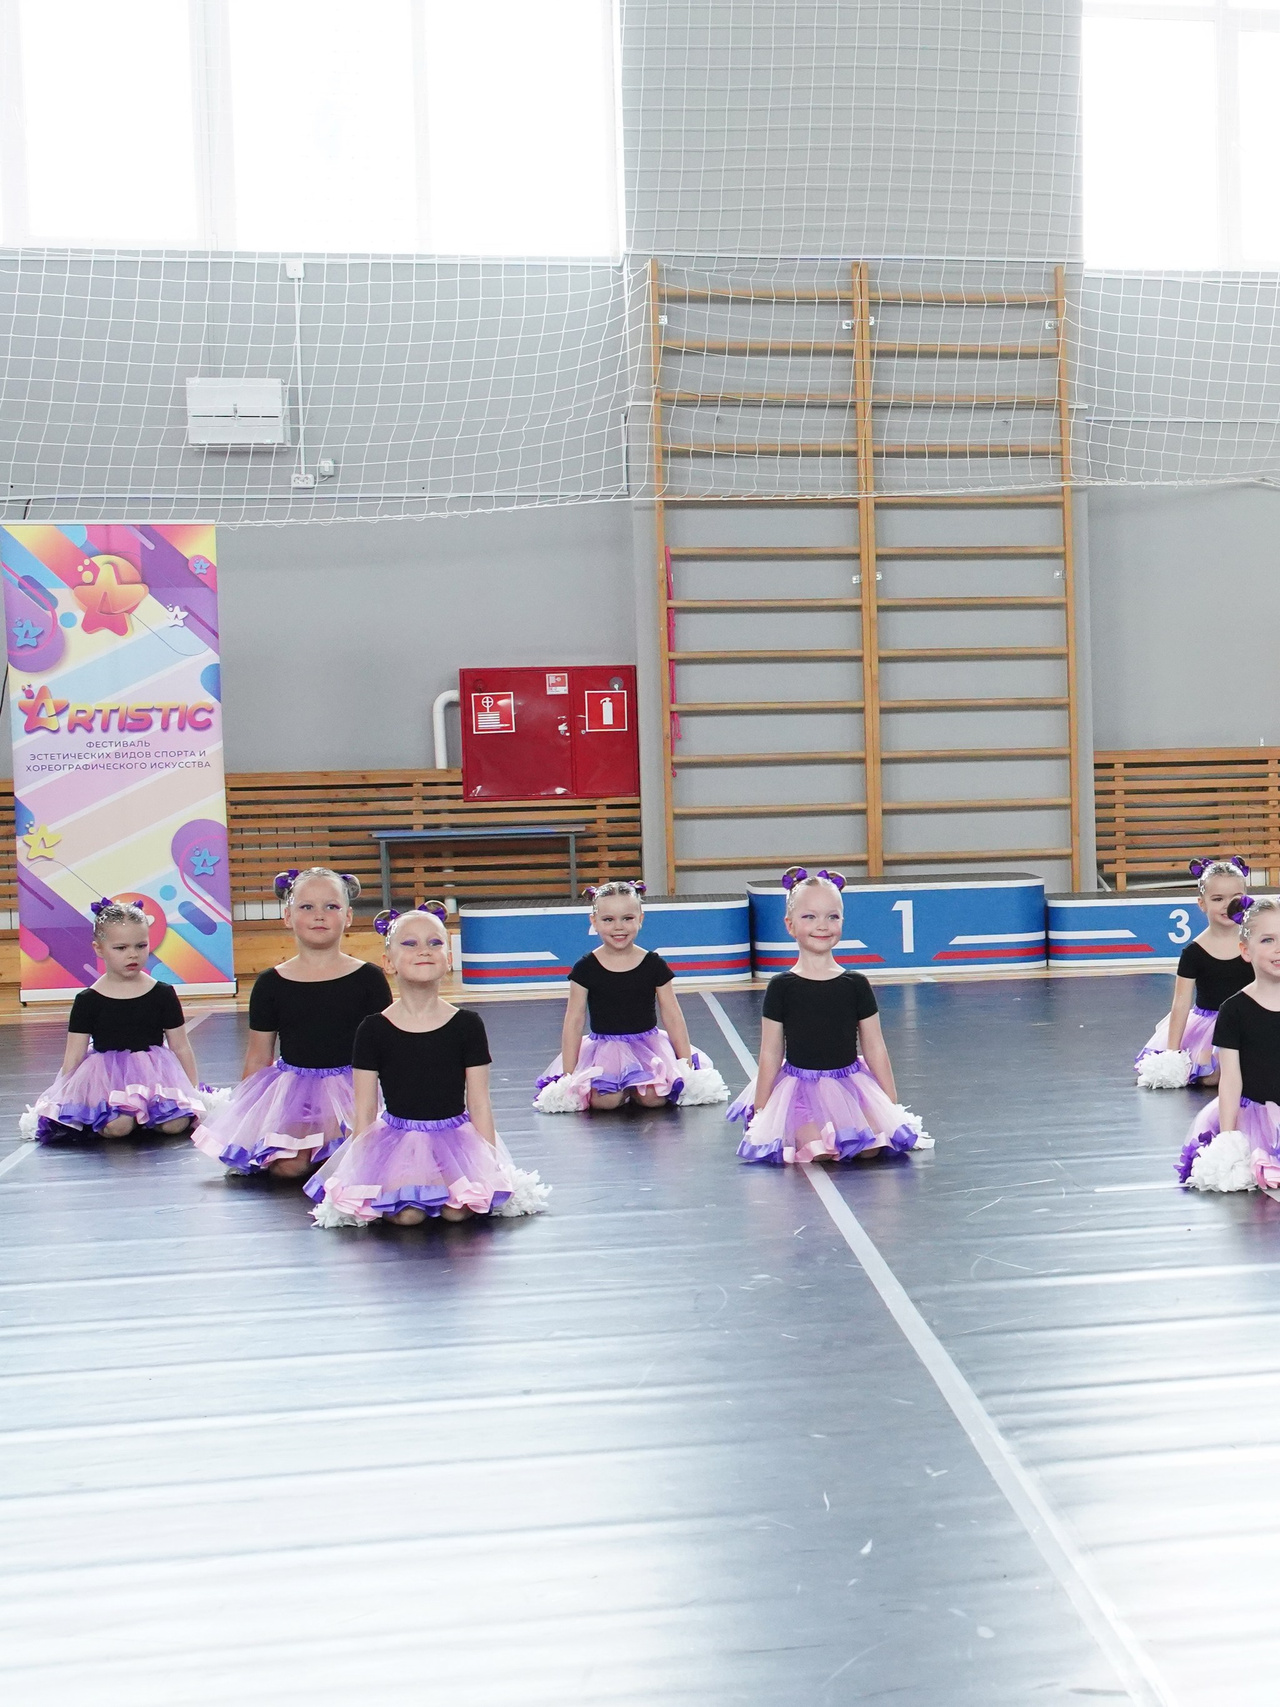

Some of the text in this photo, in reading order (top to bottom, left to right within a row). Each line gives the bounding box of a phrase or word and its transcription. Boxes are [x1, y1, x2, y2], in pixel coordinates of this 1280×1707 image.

[17, 684, 215, 735] ARTISTIC
[29, 752, 111, 761] ЭСТЕТИЧЕСКИХ
[114, 751, 151, 760] ВИДОВ
[154, 750, 197, 758] СПОРТА
[86, 740, 151, 749] ФЕСТИВАЛЬ
[25, 761, 211, 772] ХОРЕОГРАФИЧЕСКОГО ИСКУССТВА
[891, 900, 914, 953] 1
[1168, 909, 1192, 944] 3
